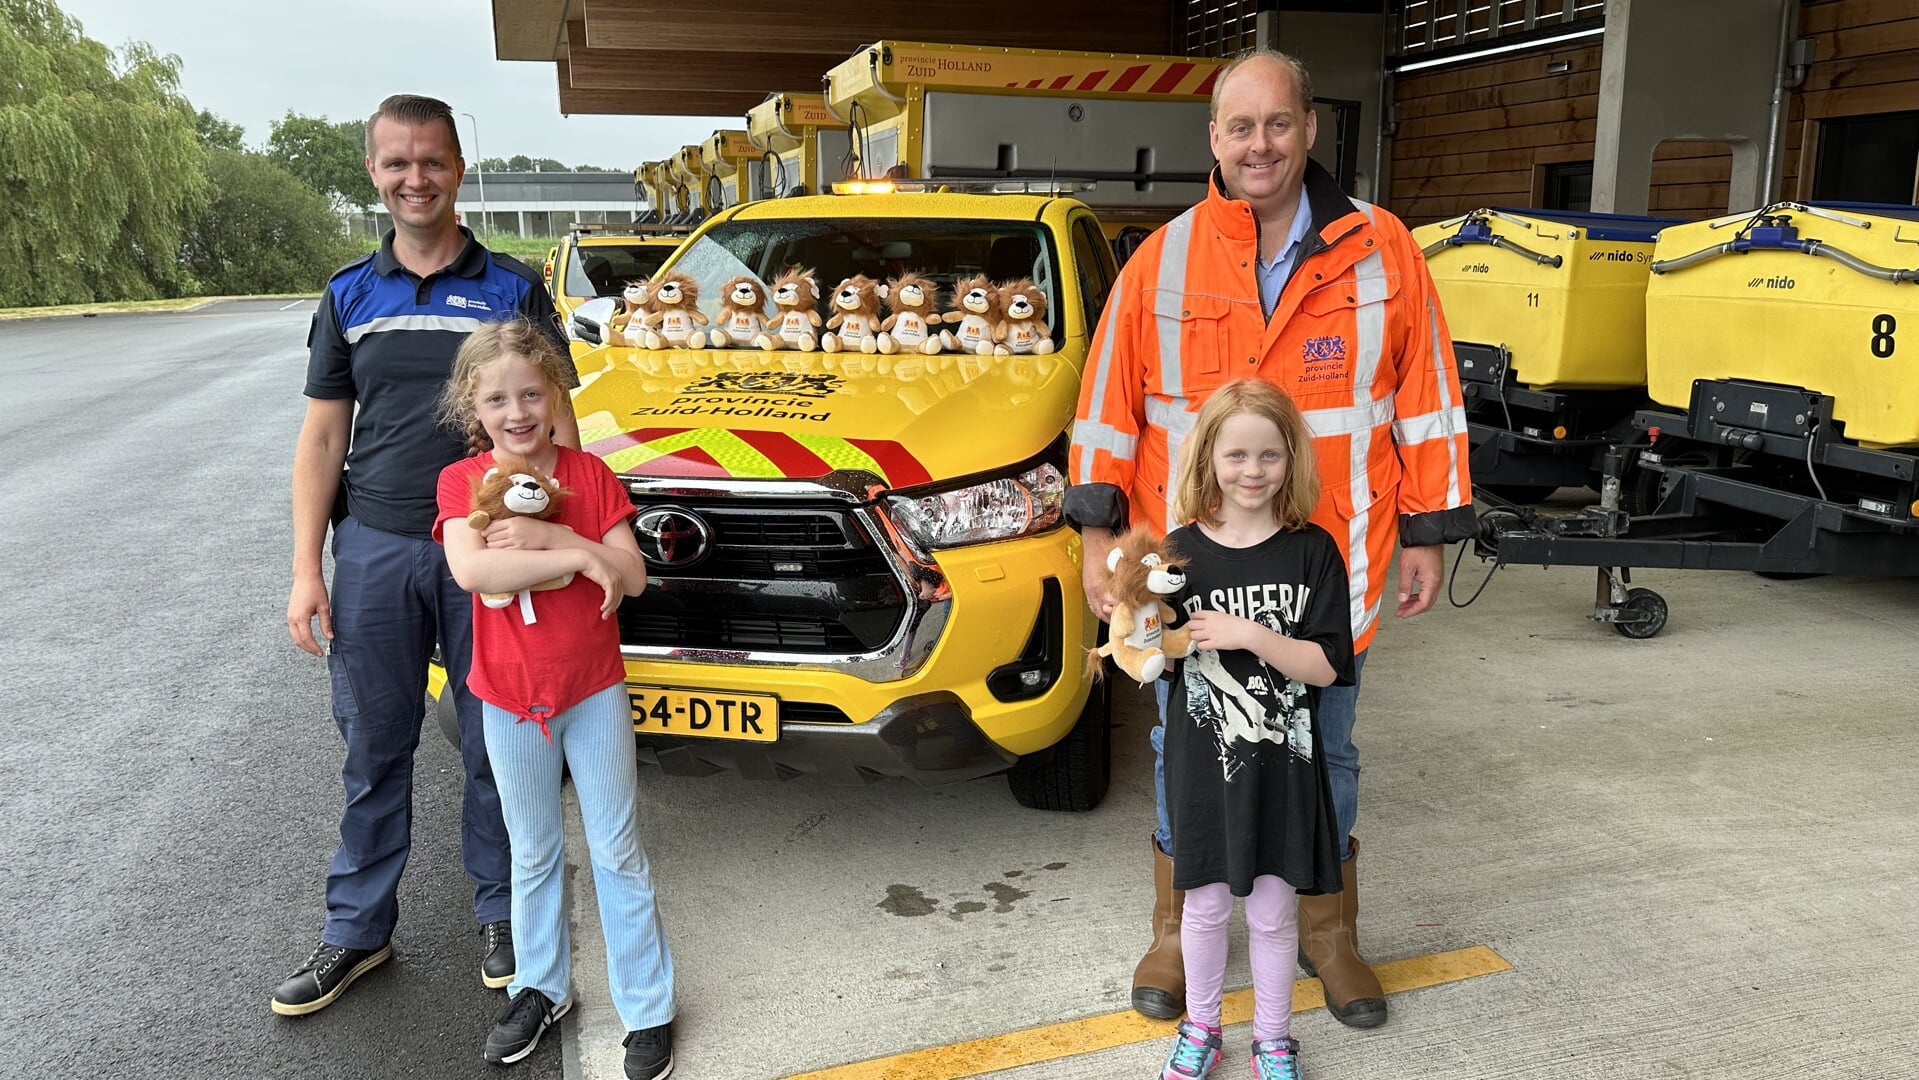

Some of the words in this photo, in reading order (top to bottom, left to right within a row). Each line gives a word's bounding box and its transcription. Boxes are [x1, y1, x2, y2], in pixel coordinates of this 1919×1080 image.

[907, 65, 936, 77] ZUID
[938, 59, 992, 72] HOLLAND
[804, 111, 827, 120] ZUID
[1607, 250, 1633, 262] nido
[1472, 263, 1489, 274] nido
[1766, 276, 1795, 290] nido
[1527, 293, 1539, 307] 11
[1870, 313, 1897, 359] 8
[1305, 363, 1343, 373] provincie
[1298, 371, 1349, 383] Zuid-Holland
[670, 396, 813, 407] provincie
[630, 406, 831, 422] Zuid-Holland
